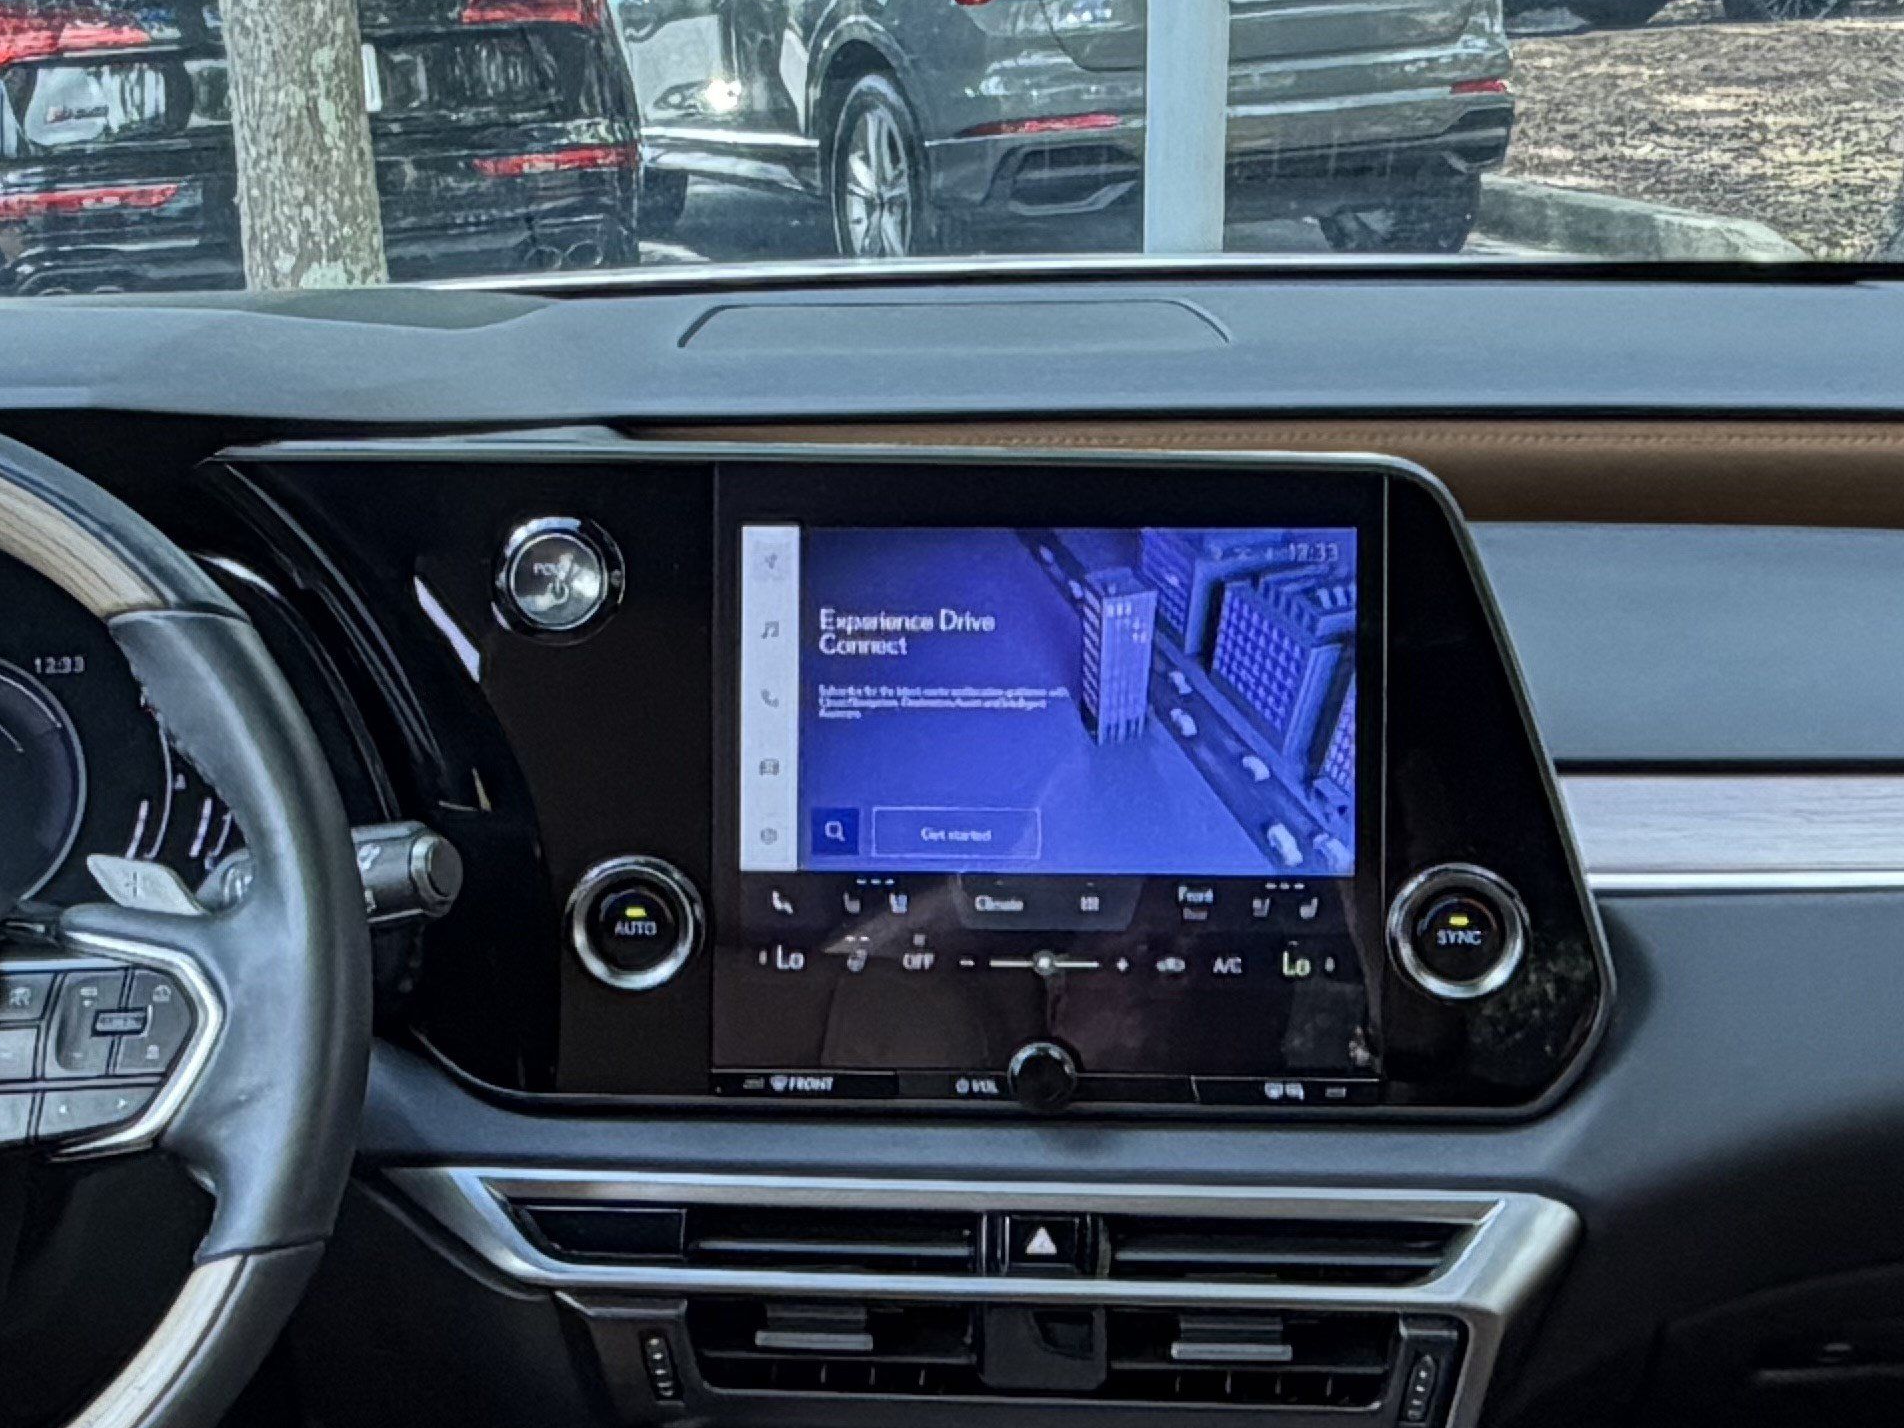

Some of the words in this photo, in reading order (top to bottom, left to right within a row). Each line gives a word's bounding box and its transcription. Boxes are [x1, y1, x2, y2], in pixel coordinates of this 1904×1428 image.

[1288, 542, 1338, 562] 12:33
[819, 608, 935, 635] Experience
[939, 608, 997, 632] Drive
[818, 632, 909, 656] Connect
[920, 826, 946, 842] Get
[948, 830, 992, 842] started
[974, 895, 1025, 912] Climate
[614, 920, 657, 936] AUTO
[1436, 928, 1482, 946] SYNC
[776, 944, 805, 971] Lo
[902, 952, 935, 971] OFF
[1212, 956, 1243, 974] A/C
[1282, 949, 1312, 977] Lo
[788, 1075, 834, 1092] FRONT
[971, 1078, 999, 1095] VOL
